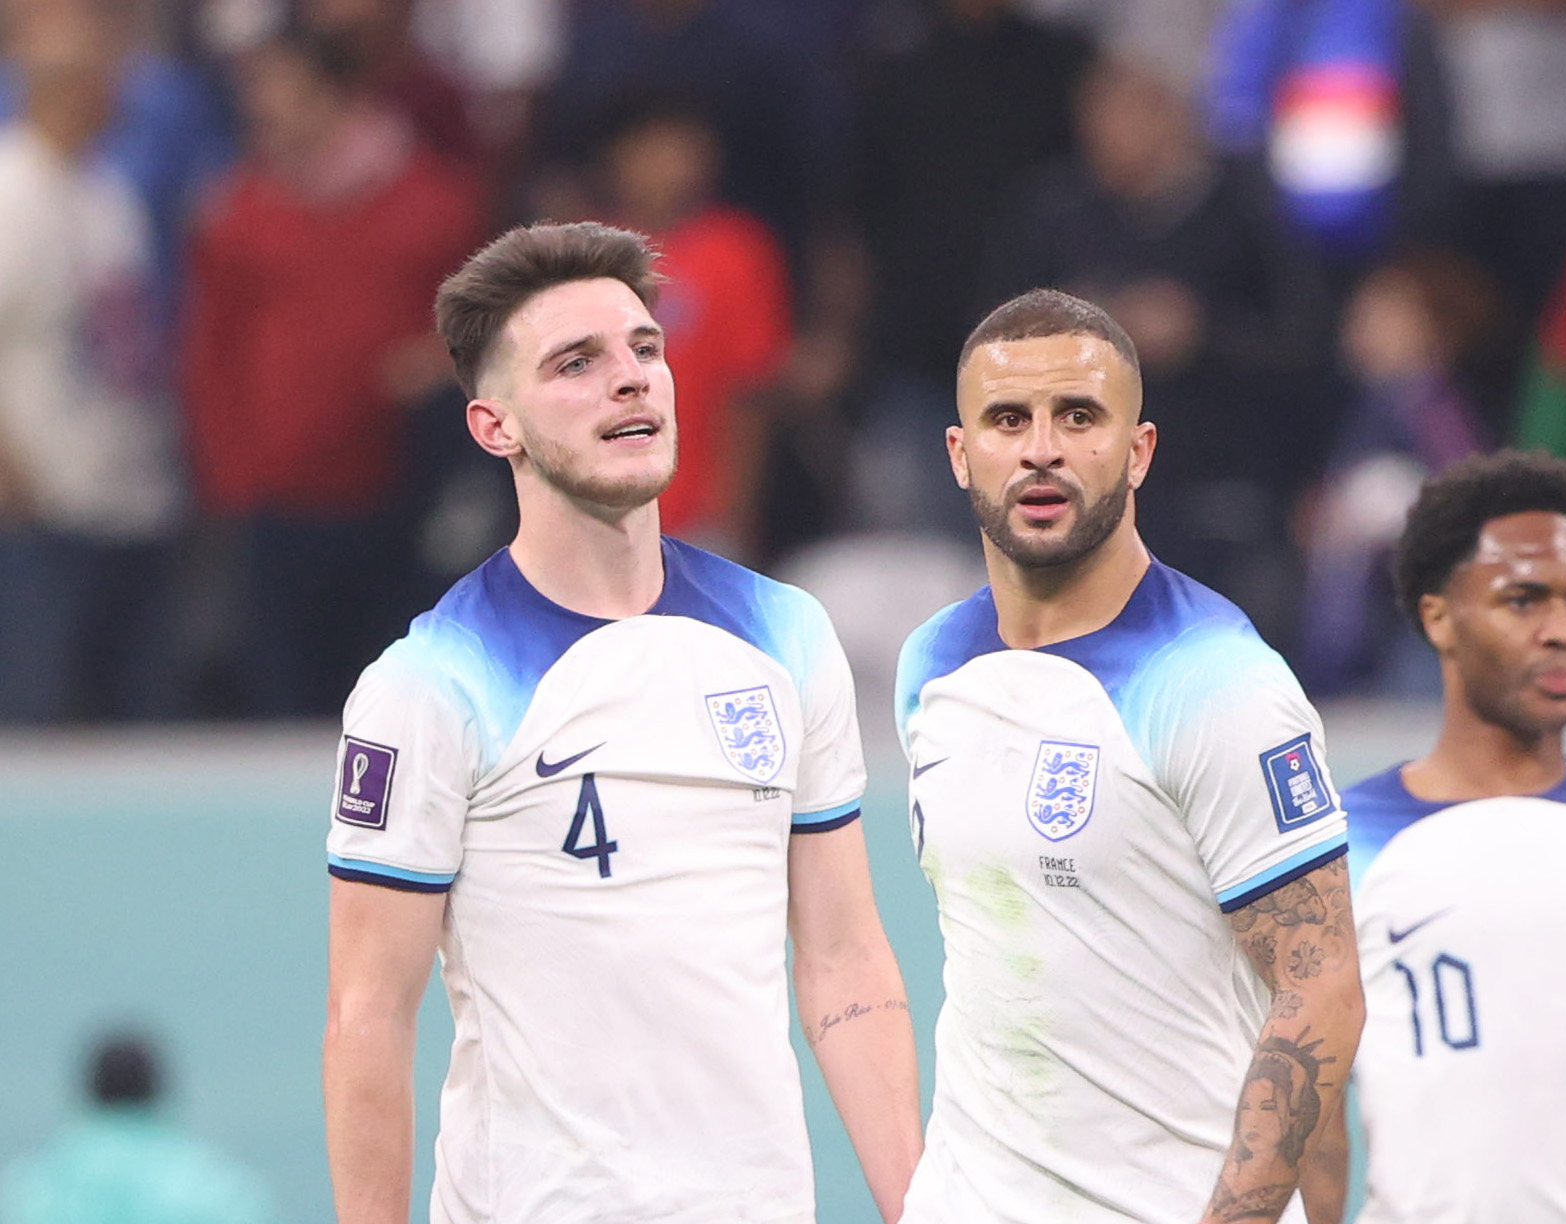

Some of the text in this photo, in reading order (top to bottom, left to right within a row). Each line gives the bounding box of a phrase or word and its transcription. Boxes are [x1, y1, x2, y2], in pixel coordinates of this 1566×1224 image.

[562, 772, 618, 878] 4
[1039, 856, 1076, 873] FRANCE
[1393, 952, 1479, 1057] 10
